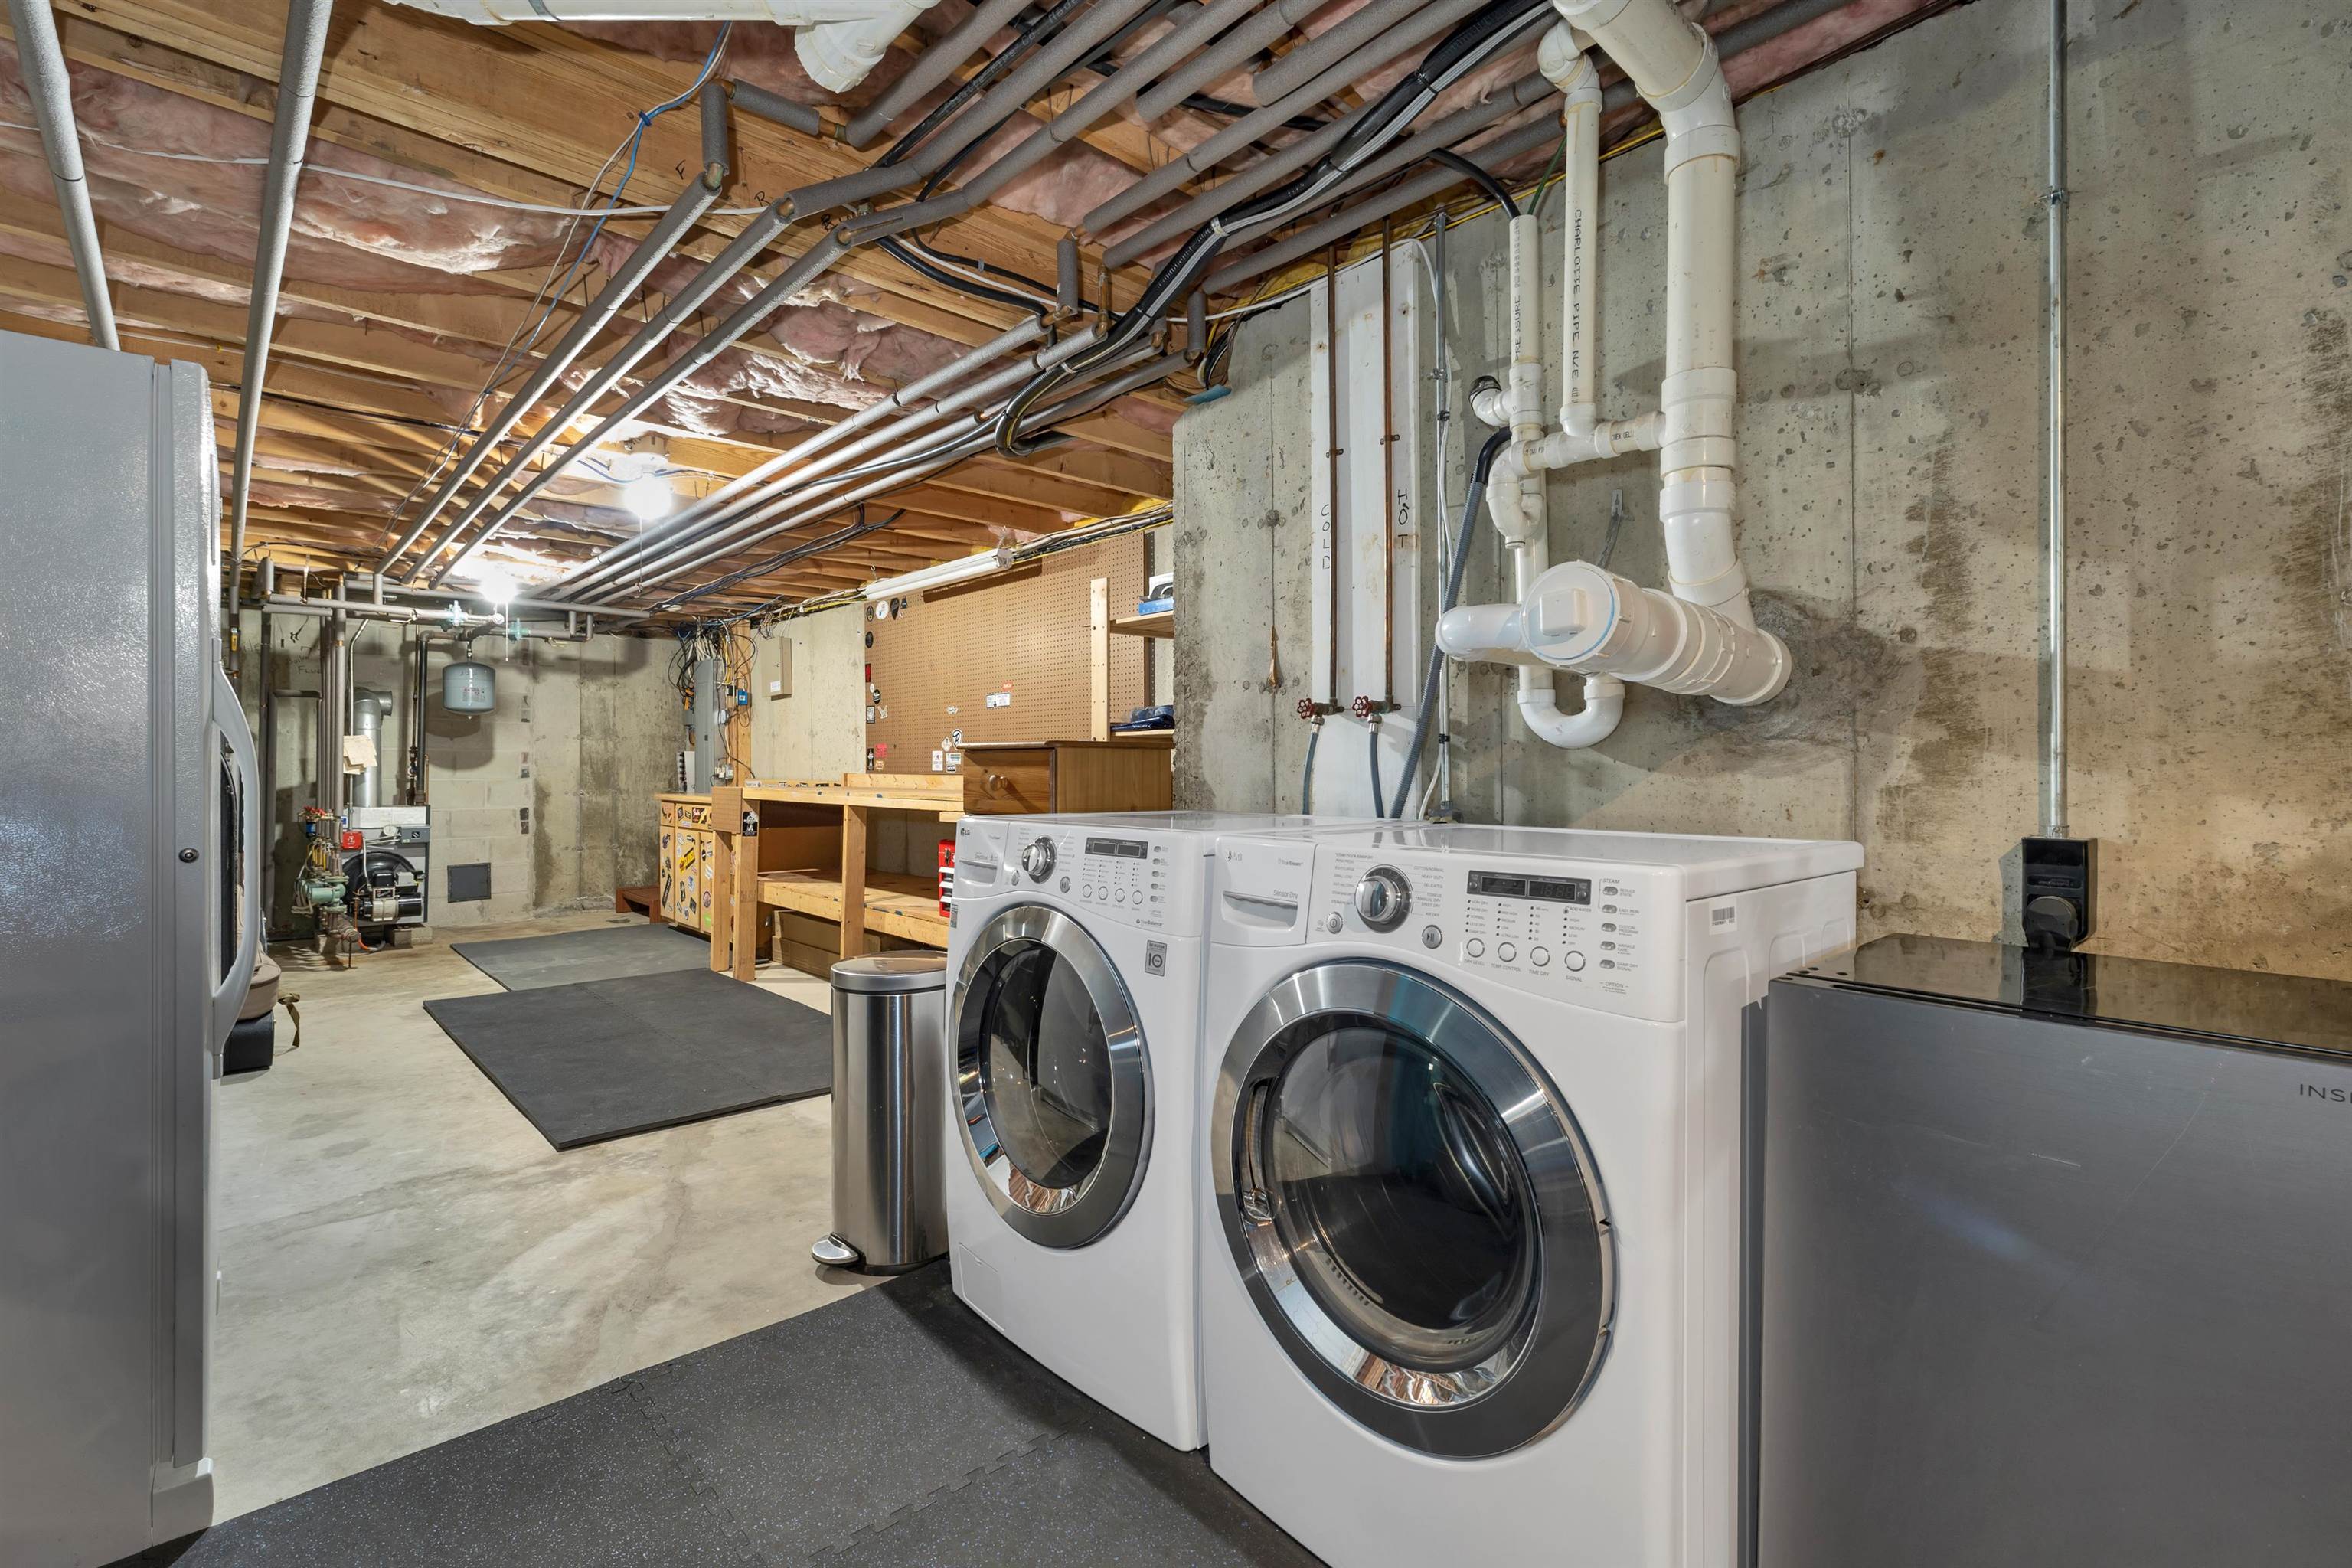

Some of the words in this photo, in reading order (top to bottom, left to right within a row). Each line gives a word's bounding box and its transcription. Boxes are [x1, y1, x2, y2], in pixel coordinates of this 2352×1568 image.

[1573, 209, 1582, 293] CHARLOTTE
[1572, 302, 1580, 341] PIPE
[1321, 504, 1331, 570] COLD
[1398, 488, 1408, 548] HOT
[1289, 891, 1298, 900] Dry
